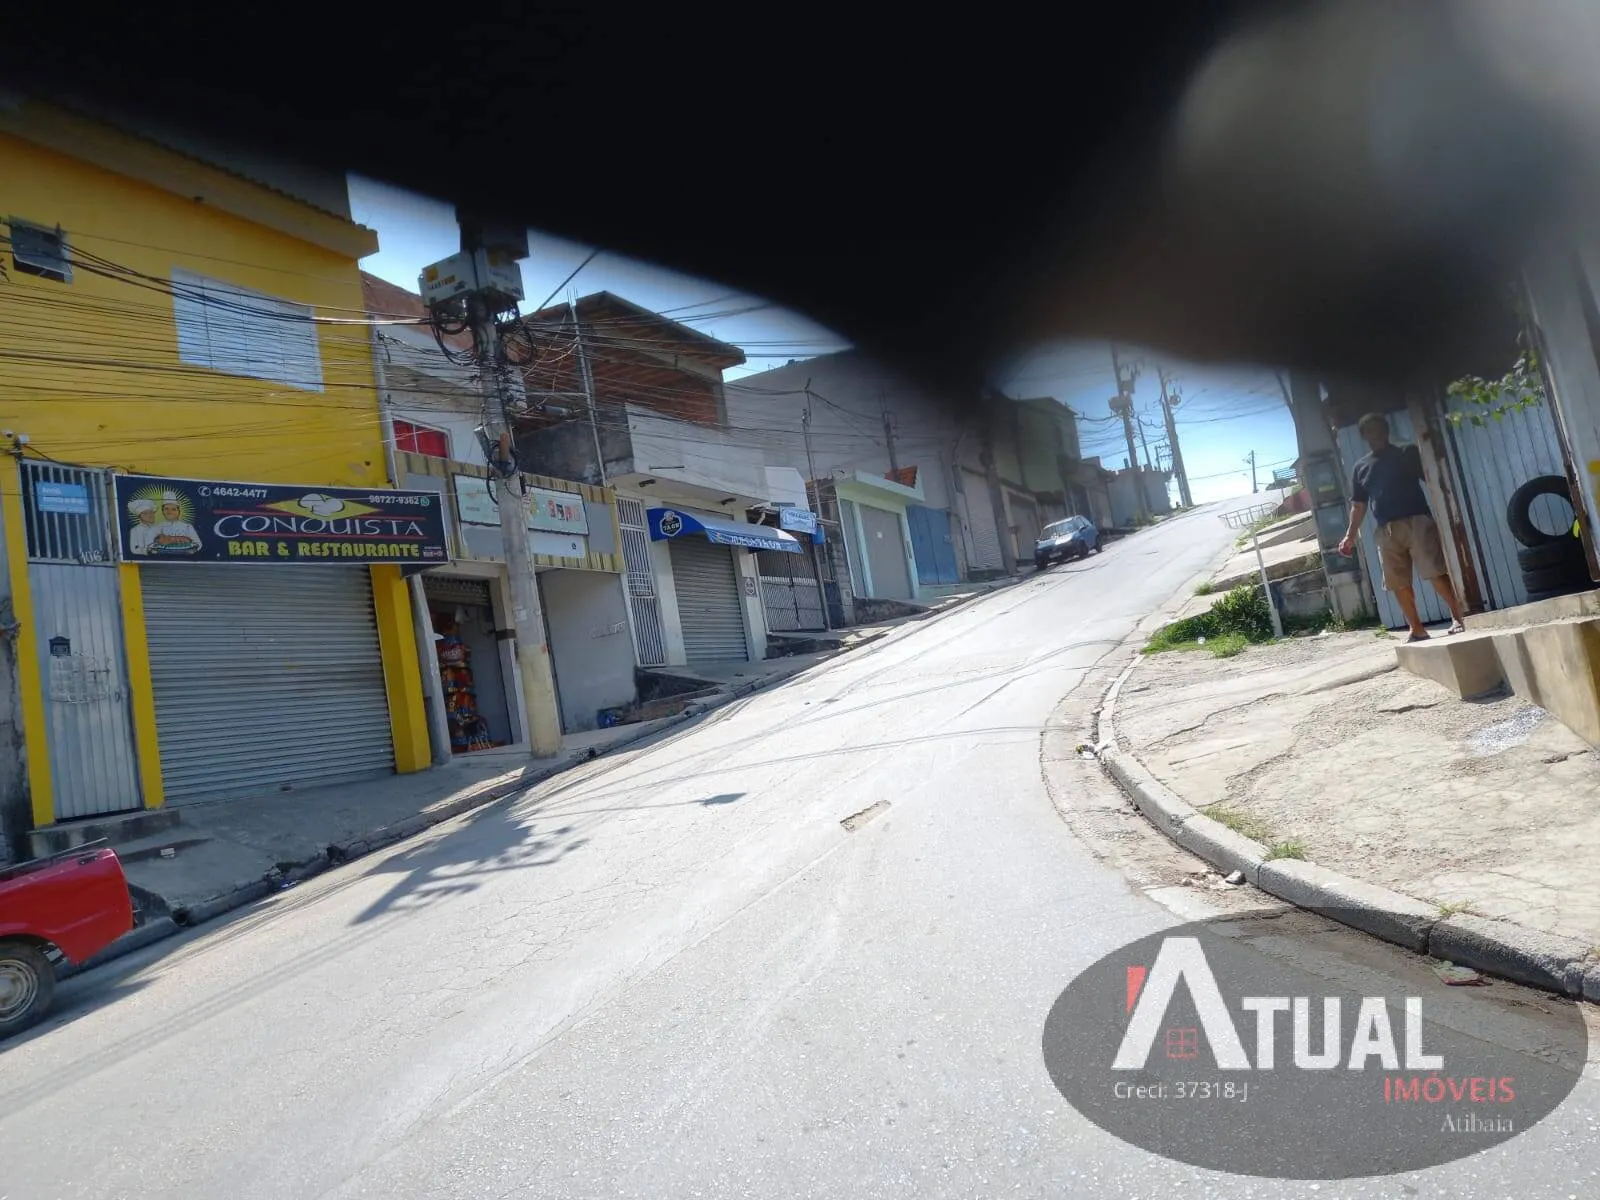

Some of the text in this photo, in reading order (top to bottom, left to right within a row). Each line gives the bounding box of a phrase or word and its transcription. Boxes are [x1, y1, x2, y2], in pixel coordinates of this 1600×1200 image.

[213, 487, 268, 498] 4642-4477
[213, 514, 424, 539] CONQUISTA
[227, 540, 271, 557] BAR
[277, 541, 291, 557] &
[299, 541, 420, 558] RESTAURANTE
